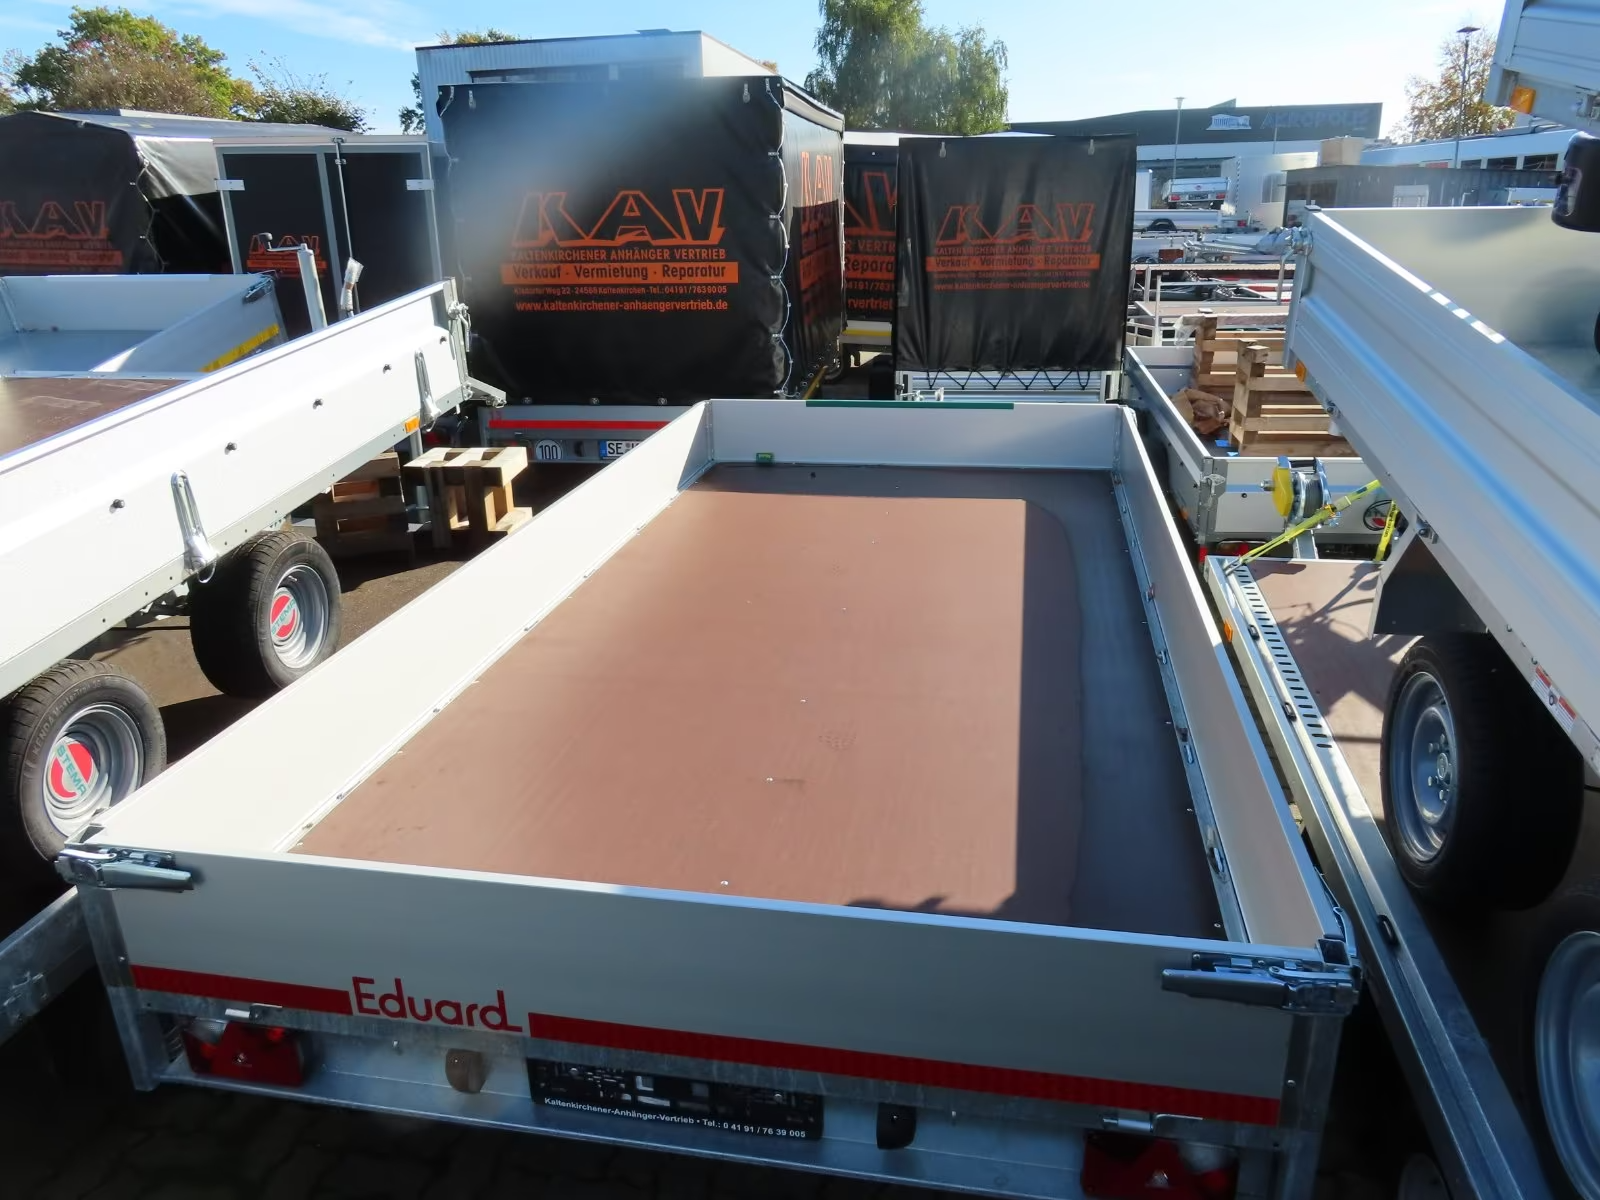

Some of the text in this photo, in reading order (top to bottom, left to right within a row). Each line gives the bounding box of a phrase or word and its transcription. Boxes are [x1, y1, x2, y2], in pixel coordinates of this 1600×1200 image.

[512, 188, 724, 248] KAV
[935, 203, 1094, 244] KAV
[513, 264, 726, 280] Verkauf Vermietung Reparatur
[610, 248, 670, 260] ANHÄNGER
[674, 249, 726, 259] VERTRIEB
[516, 299, 728, 312] www.kaltenkirchener-anhaengervertrieb.de
[539, 445, 558, 460] 100
[608, 443, 623, 454] SE
[273, 599, 296, 636] STEMA
[32, 715, 55, 756] KENDA
[57, 745, 87, 796] STEMA
[352, 976, 523, 1033] Eduard
[544, 1097, 694, 1124] Kaltenkirchener-Anhänger-Vertrieb
[702, 1118, 721, 1128] Tel.:
[723, 1121, 729, 1129] 0
[731, 1122, 741, 1131] 41
[743, 1124, 754, 1133] 91
[762, 1127, 774, 1135] 76
[776, 1128, 787, 1136] 39
[789, 1129, 806, 1138] 005
